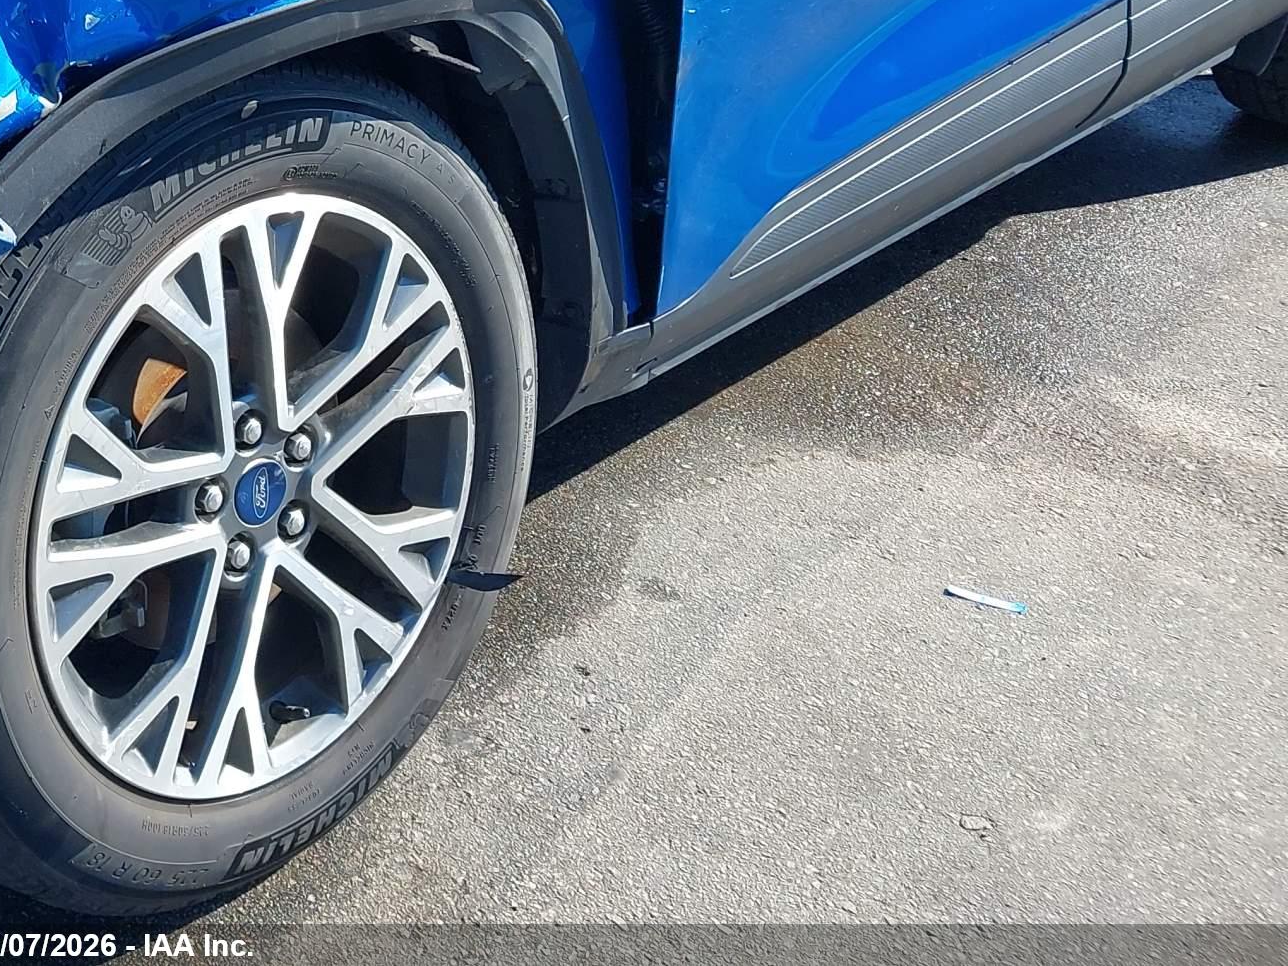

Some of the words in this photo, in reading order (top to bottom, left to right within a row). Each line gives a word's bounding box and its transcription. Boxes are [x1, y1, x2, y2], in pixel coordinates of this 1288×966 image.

[149, 116, 324, 212] MICHELIN
[349, 119, 431, 165] PRIMACY
[256, 475, 266, 508] Ford
[230, 752, 393, 876] MICHELIN
[112, 861, 133, 879] R
[132, 867, 162, 884] 60
